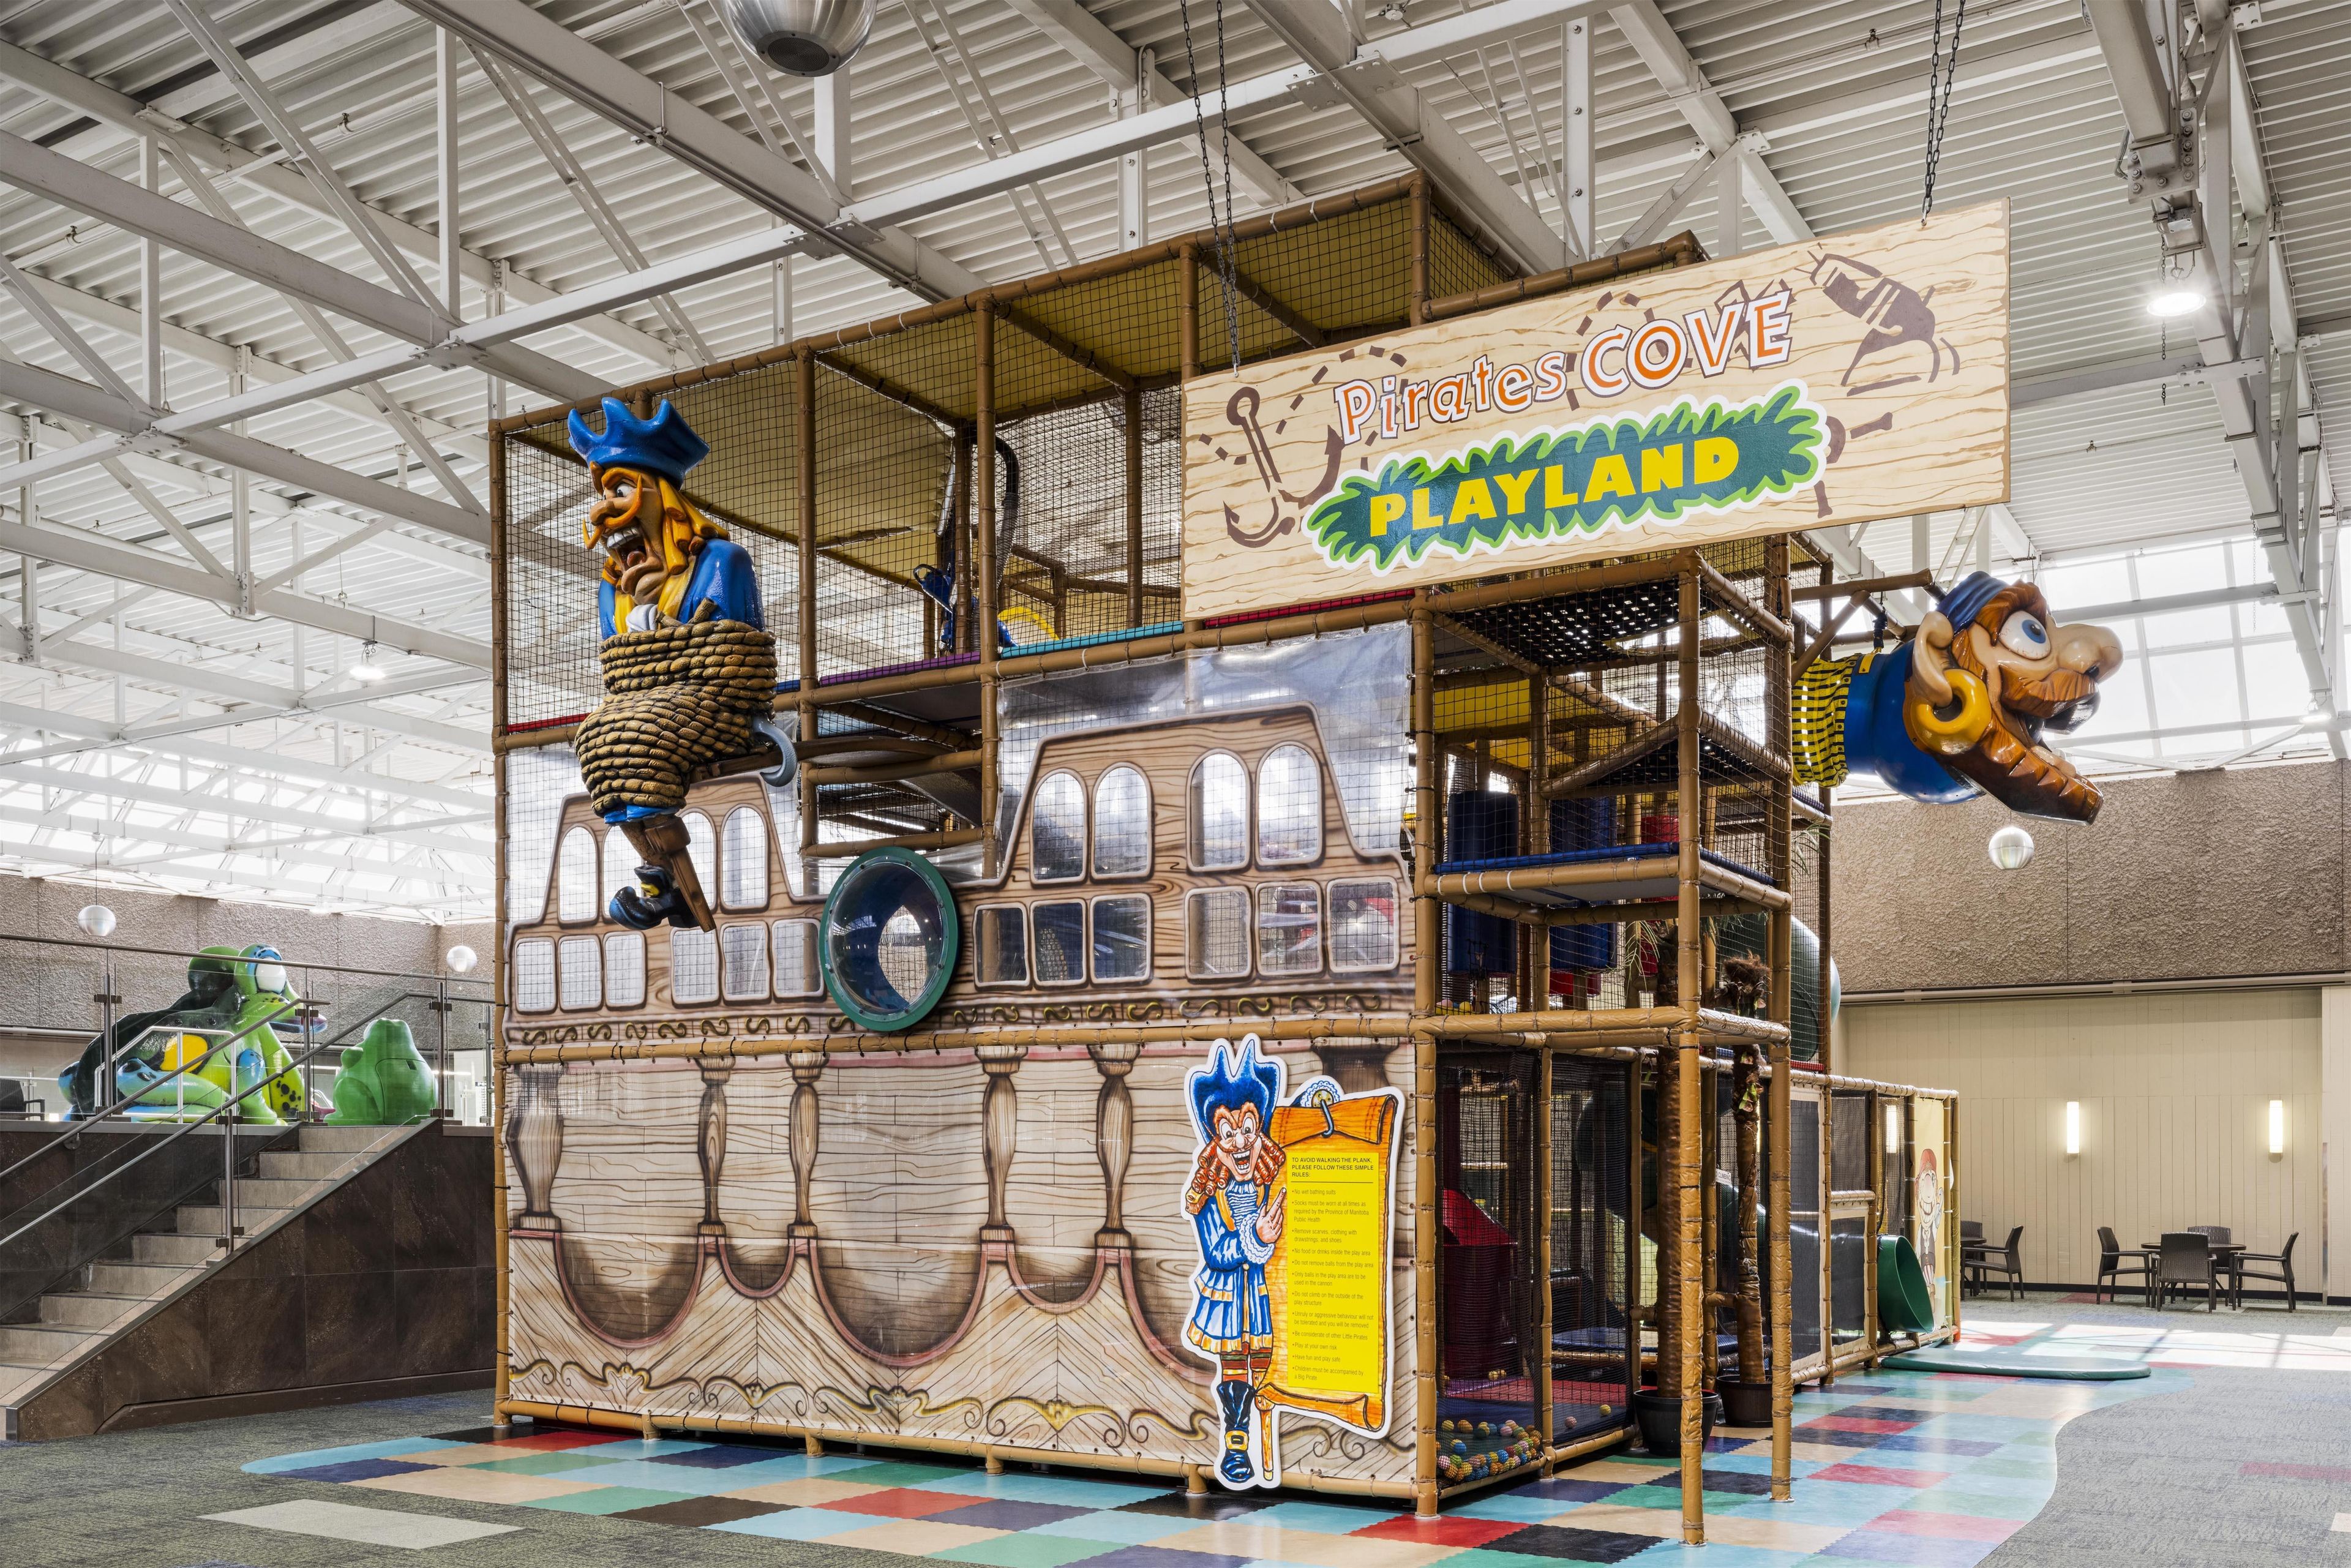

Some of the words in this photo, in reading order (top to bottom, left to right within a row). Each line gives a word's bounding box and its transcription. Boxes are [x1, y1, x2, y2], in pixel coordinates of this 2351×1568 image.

[1334, 351, 1568, 445] Pirates
[1581, 289, 1793, 397] COVE
[1370, 437, 1739, 536] PLAYLAND
[1329, 1367, 1357, 1376] accompanied
